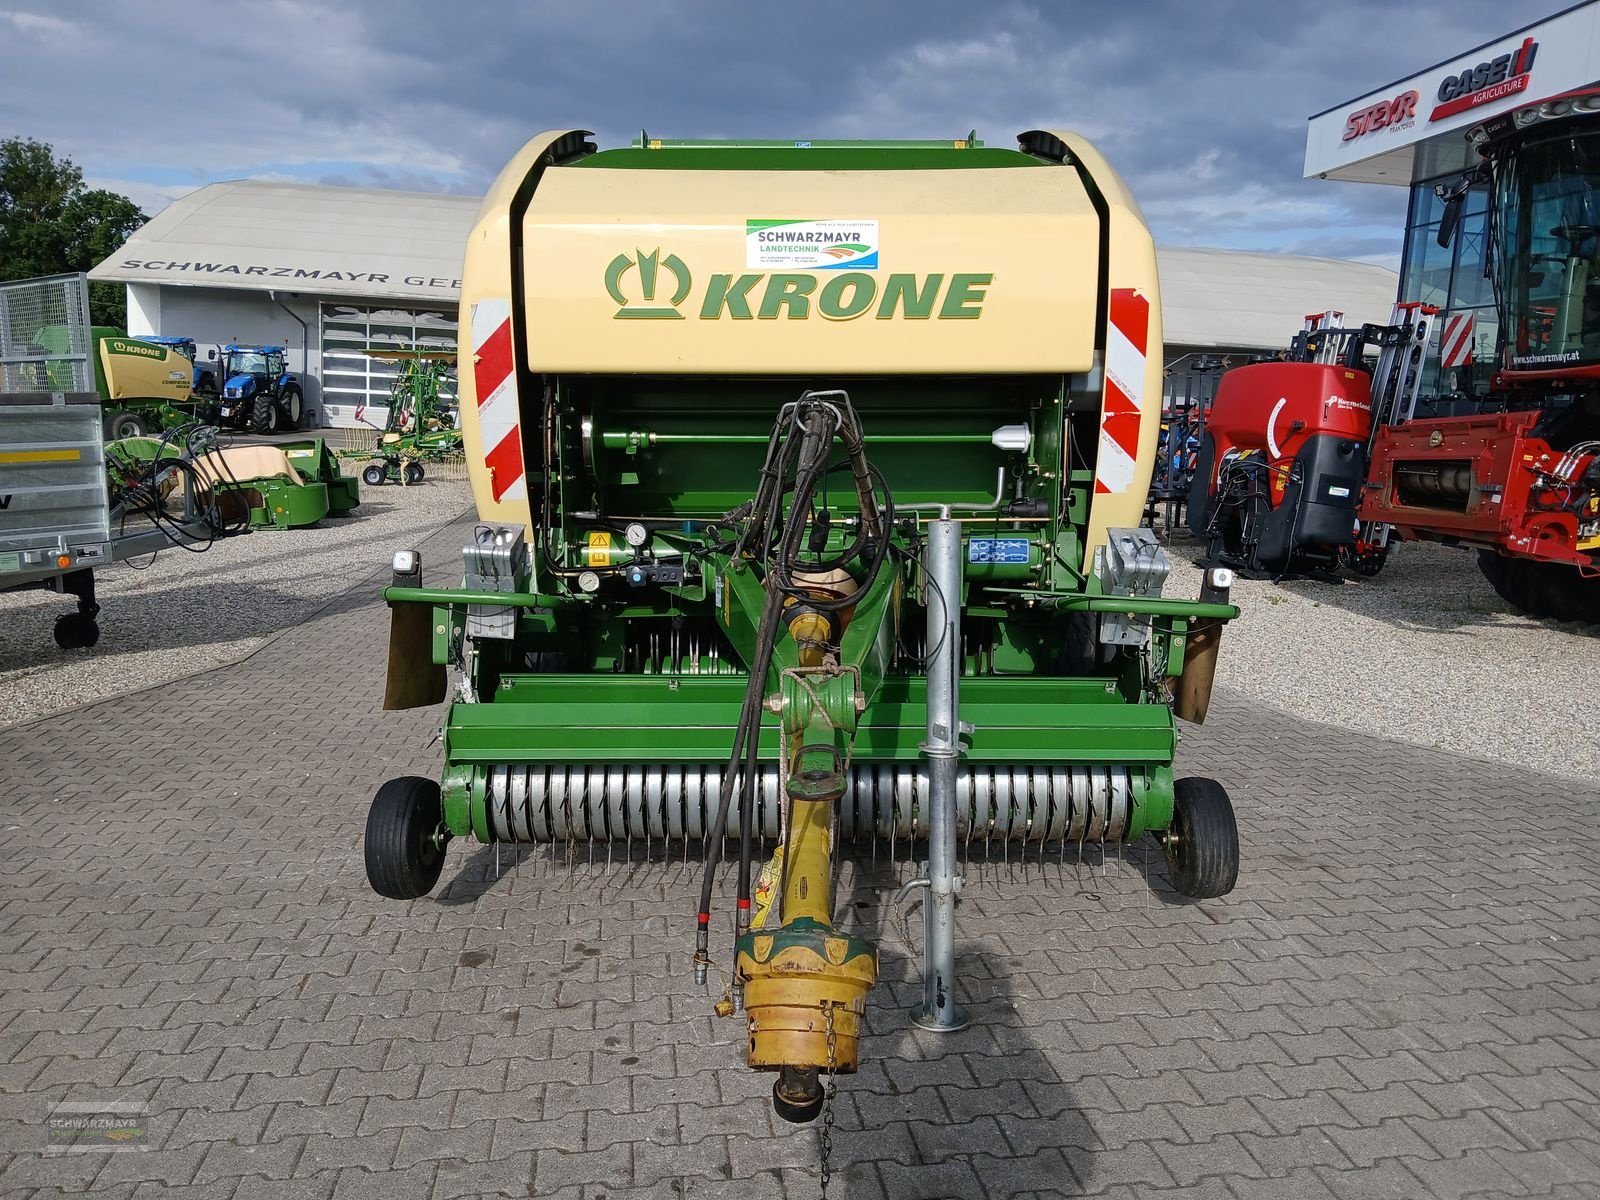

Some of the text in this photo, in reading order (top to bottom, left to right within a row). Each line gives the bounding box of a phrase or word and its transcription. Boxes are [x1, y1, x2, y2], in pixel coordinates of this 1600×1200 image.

[1438, 53, 1511, 102] CASE
[1472, 78, 1523, 104] AGRICULTURE
[1342, 90, 1419, 141] STEYR
[1389, 120, 1416, 134] TRAKTOREN
[758, 232, 861, 242] SCHWARZMAYR
[120, 260, 389, 283] SCHWARZMAYR
[699, 272, 994, 320] KRONE
[127, 345, 160, 357] KRONE
[1513, 350, 1580, 363] www.schwarzmayr.at
[1337, 398, 1371, 411] Kverneland
